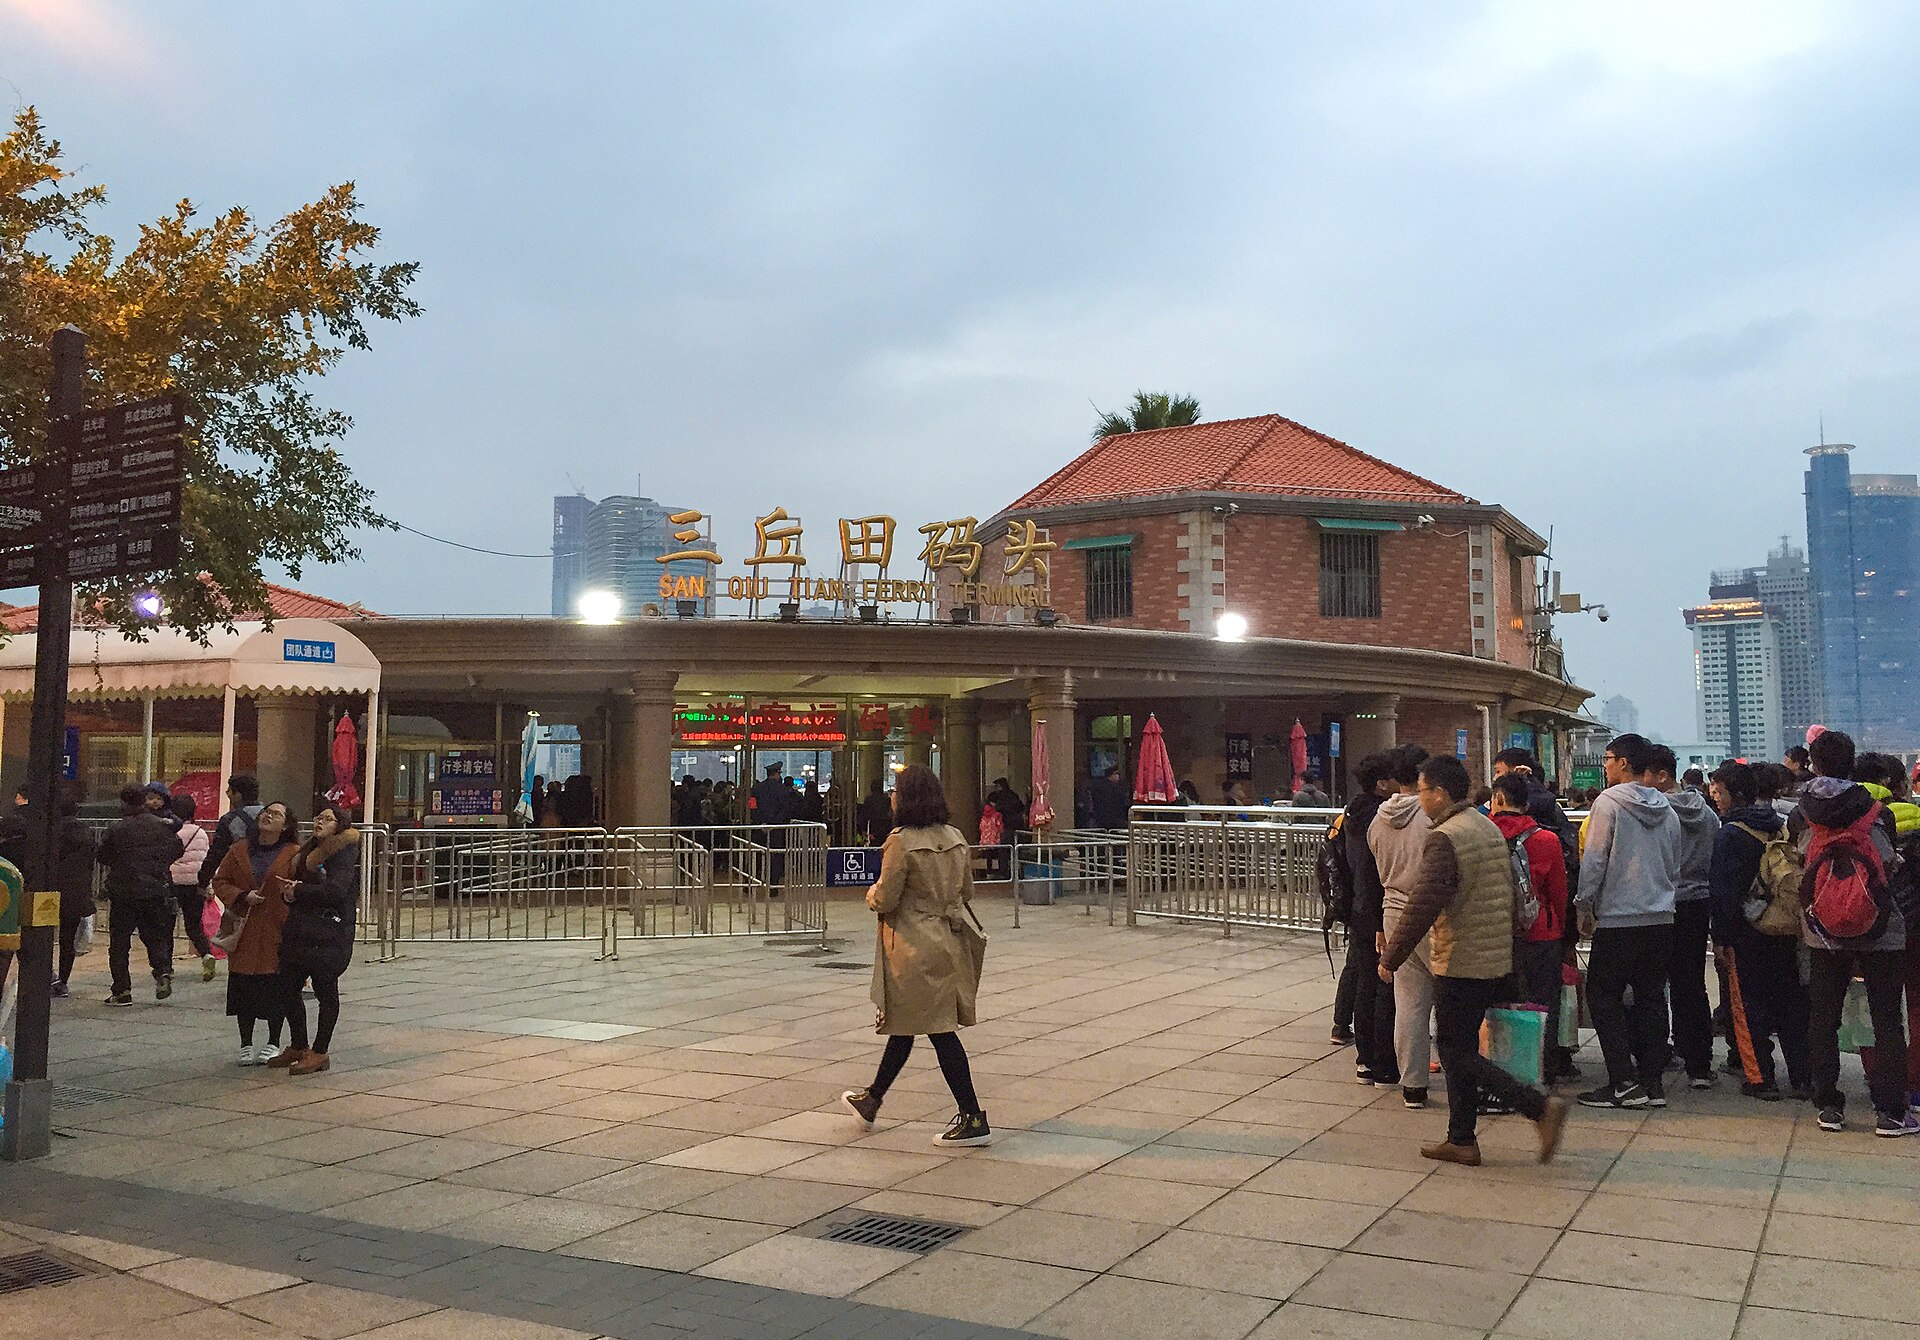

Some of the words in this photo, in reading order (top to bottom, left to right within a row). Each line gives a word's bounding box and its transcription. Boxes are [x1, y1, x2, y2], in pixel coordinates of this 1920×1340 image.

[655, 506, 1057, 577] 三丘田码头
[658, 573, 704, 599] SAN
[728, 576, 769, 601] QIU
[790, 577, 844, 601] TIAN
[863, 579, 934, 604] FERRY
[949, 582, 1050, 607] TERMINAL
[286, 643, 321, 658] 团队通道
[1228, 739, 1249, 753] 行李
[442, 760, 493, 774] 行李请安检
[1229, 757, 1250, 773] 安检
[835, 873, 874, 881] 无障碍通道
